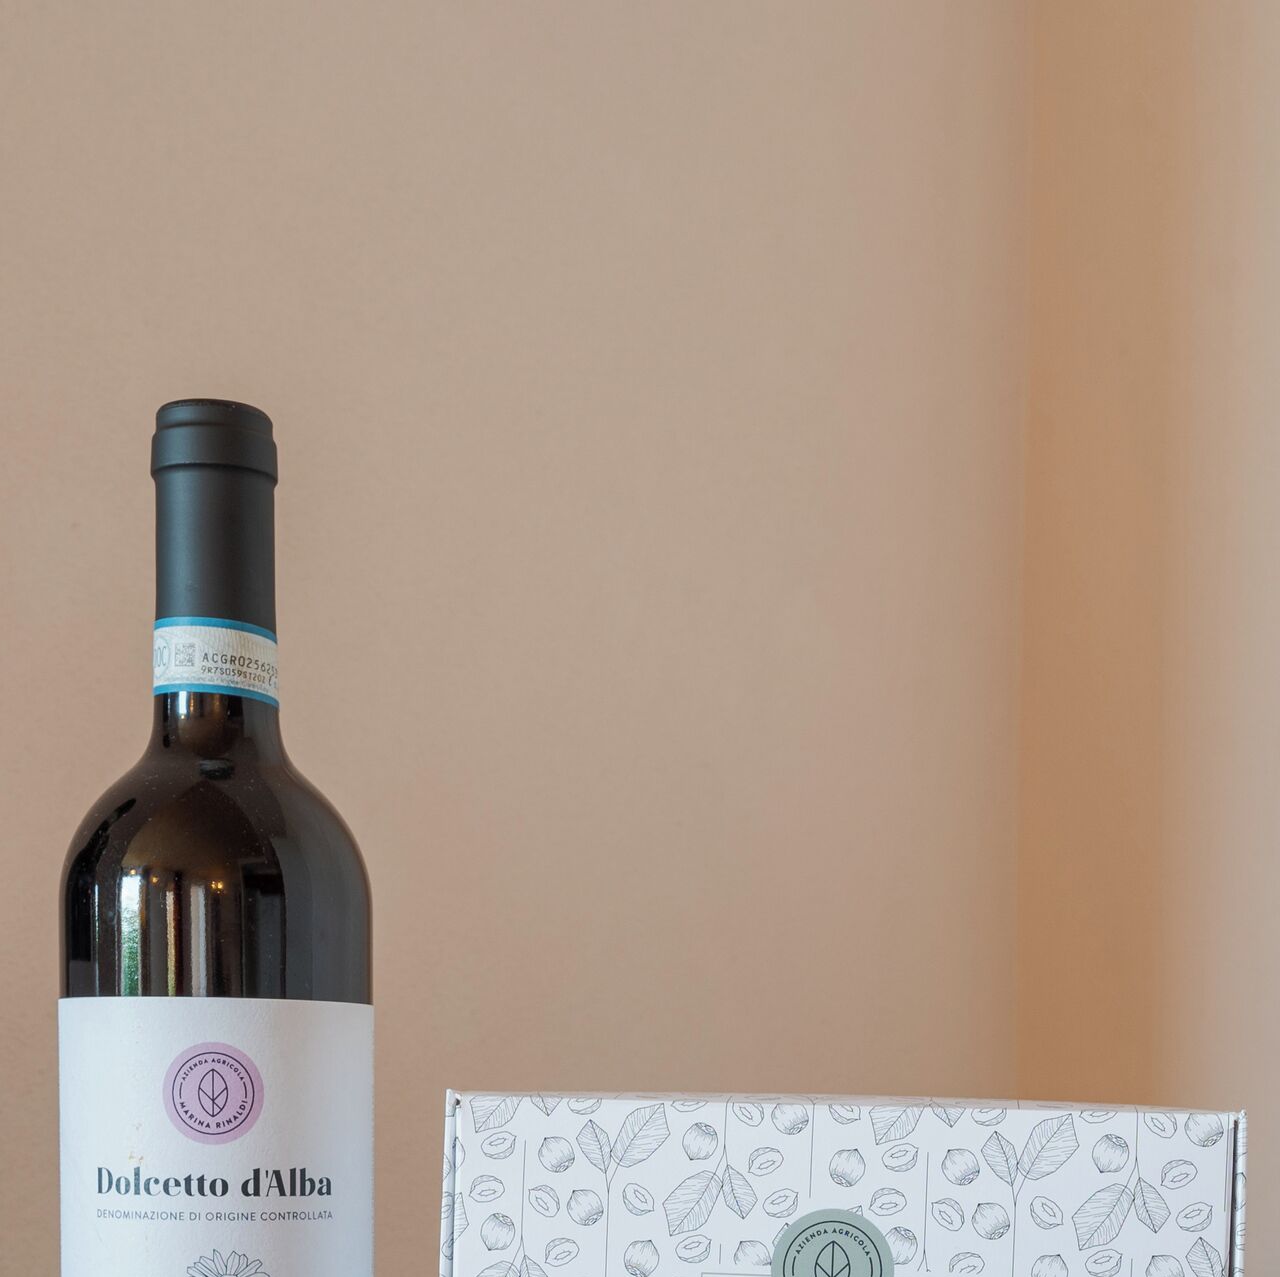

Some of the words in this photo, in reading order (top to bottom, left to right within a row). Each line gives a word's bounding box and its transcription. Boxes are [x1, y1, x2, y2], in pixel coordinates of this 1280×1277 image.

[181, 1059, 208, 1081] AZIENDA
[211, 1058, 244, 1081] AGRICOLA
[179, 1101, 211, 1129] MARINA
[216, 1100, 248, 1129] RINALDI
[97, 1166, 229, 1197] Dolcetto
[241, 1168, 332, 1197] d'Alba
[97, 1209, 185, 1221] DENOMINAZIONE
[189, 1211, 201, 1221] DI
[206, 1211, 257, 1221] ORIGINE
[260, 1210, 333, 1221] CONTROLLATA
[796, 1228, 828, 1255] AZIENDA
[831, 1227, 870, 1257] AGRICOLA
